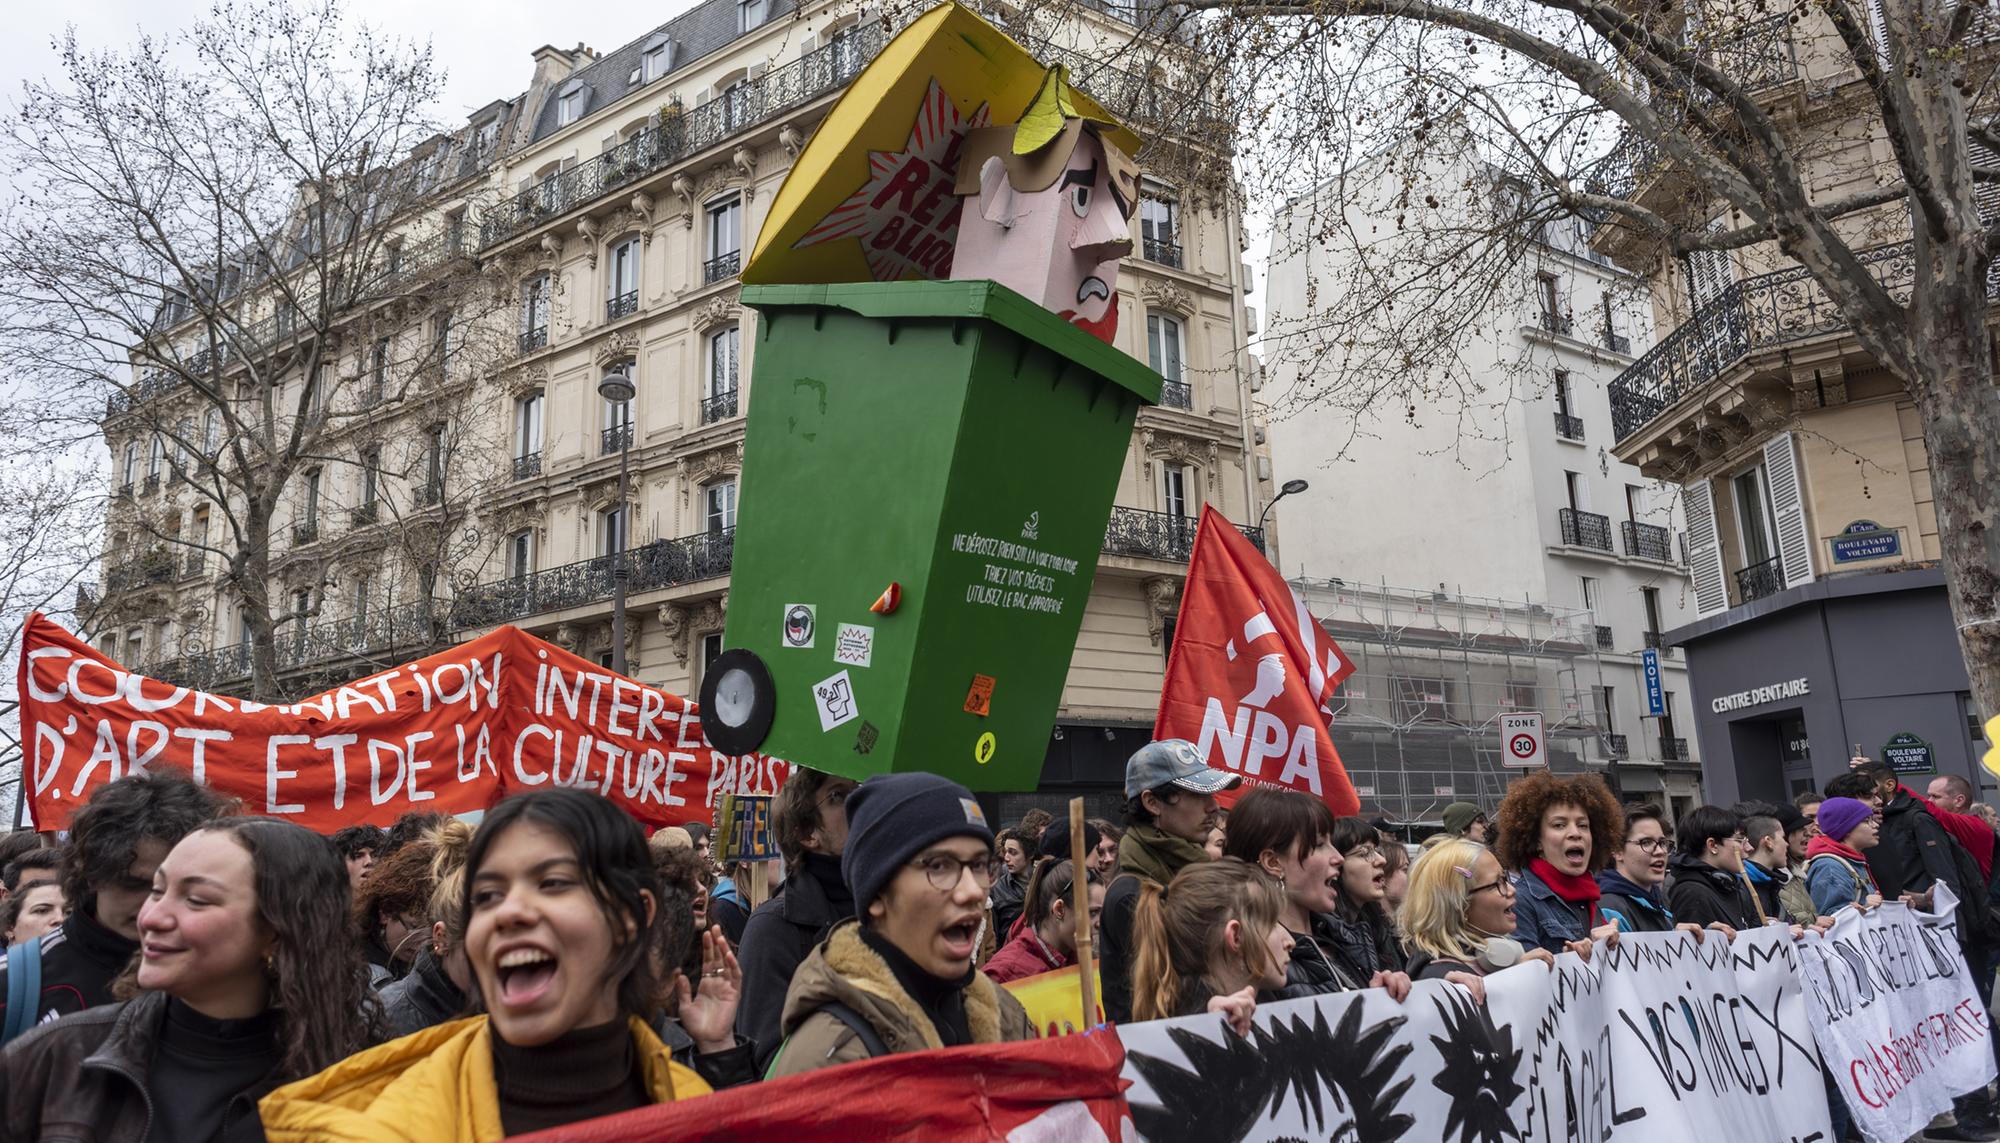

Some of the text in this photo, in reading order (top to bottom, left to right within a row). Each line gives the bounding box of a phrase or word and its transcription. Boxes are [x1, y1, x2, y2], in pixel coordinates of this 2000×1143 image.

[1021, 529, 1038, 540] PARIS
[1838, 537, 1893, 550] BOULEVARD
[952, 534, 966, 552] NE
[966, 532, 998, 557] DÉPOSEZ
[997, 541, 1015, 561] RIEN
[1026, 549, 1036, 564] LA
[1846, 546, 1888, 557] VOLTAIRE
[984, 564, 1055, 593] TRIEZ VOS DÉCHETS
[966, 584, 1003, 606] UTILISEZ
[1002, 592, 1011, 608] LE
[1012, 592, 1028, 609] BAC
[1646, 655, 1660, 708] HOTEL
[1712, 678, 1810, 713] CENTRE DENTAIRE
[1508, 719, 1536, 728] ZONE
[1197, 697, 1323, 796] NPA
[1515, 740, 1532, 752] 30
[1887, 748, 1927, 757] BOULEVARD
[456, 722, 498, 784] LA
[513, 724, 696, 806] CULTURE
[706, 750, 784, 807] PARIS
[1893, 755, 1924, 763] VOLTAIRE
